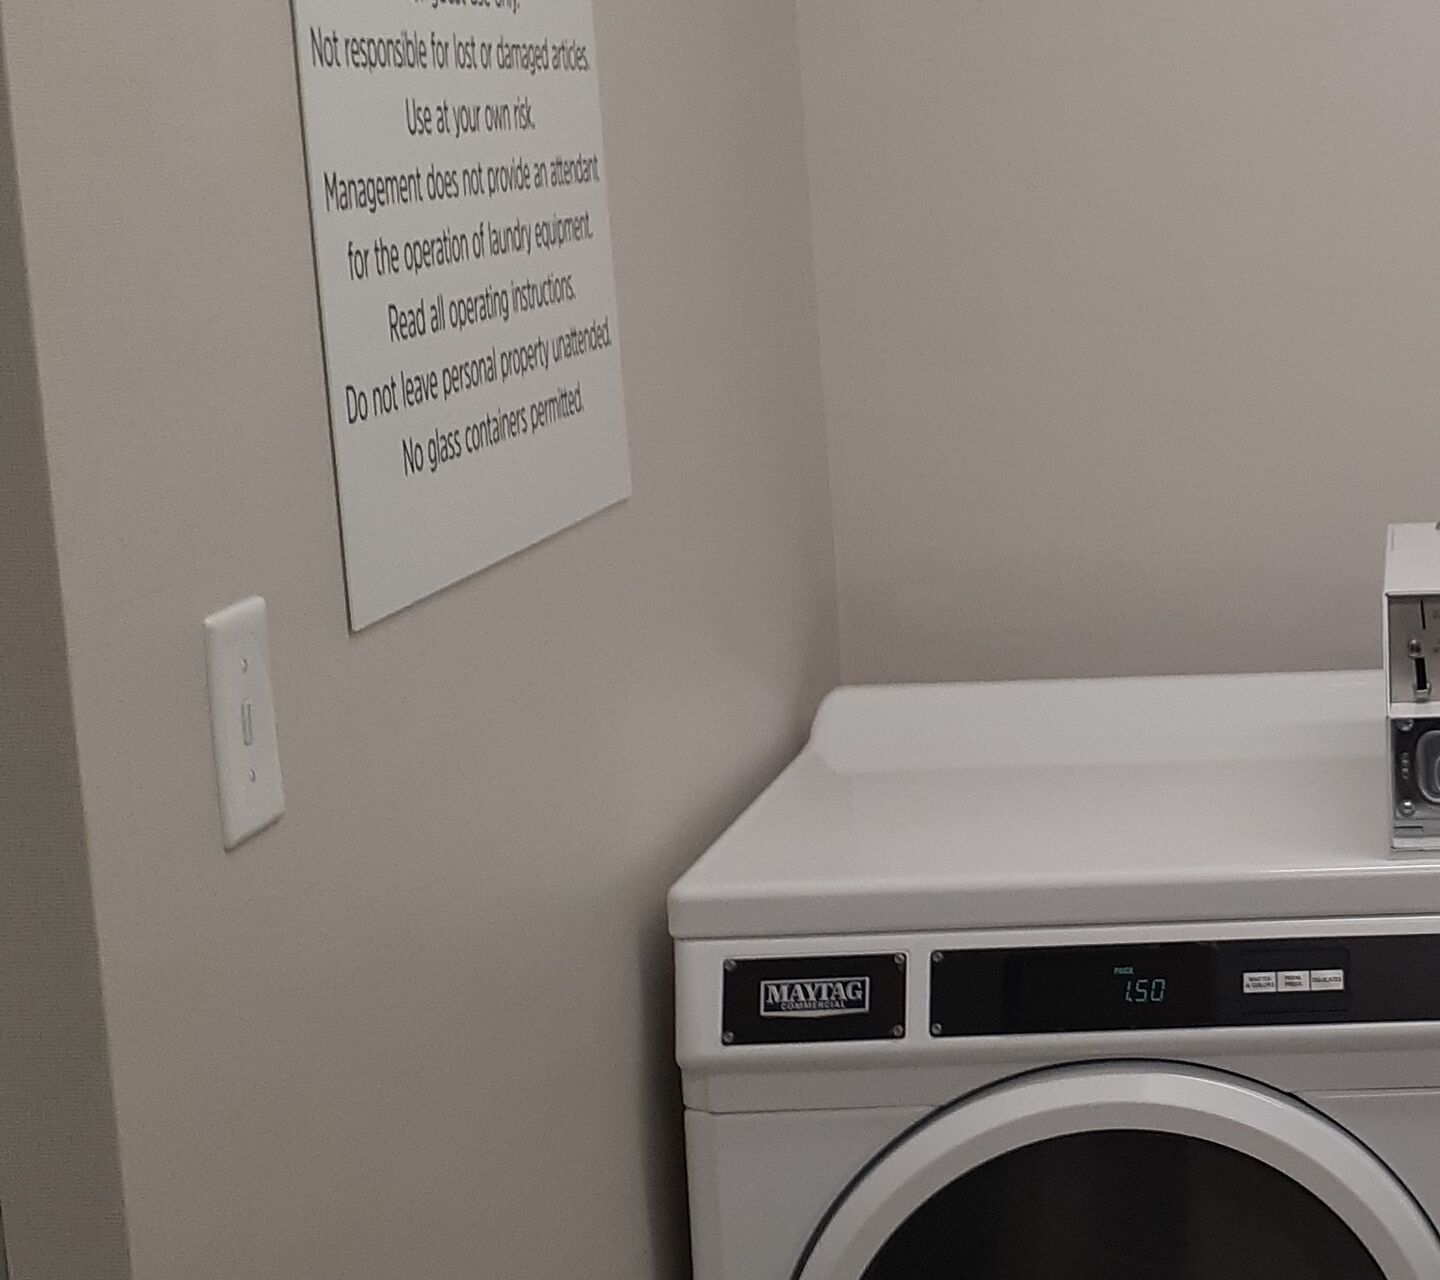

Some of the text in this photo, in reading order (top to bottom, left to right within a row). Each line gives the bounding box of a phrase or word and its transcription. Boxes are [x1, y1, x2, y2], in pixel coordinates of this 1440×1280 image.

[310, 27, 590, 75] Not responsible for lost or damaged articles.
[405, 96, 535, 138] Use at your own risk.
[324, 153, 600, 213] Management does not provide an attendant
[348, 210, 593, 281] for the operation of laundry equipment.
[388, 272, 576, 343] Read all operating instructions.
[345, 316, 612, 424] Do not leave personal property unattended.
[402, 381, 584, 476] No glass containers permitted.
[766, 981, 863, 1004] MAYTAG
[780, 1001, 846, 1011] COMMERCIAL
